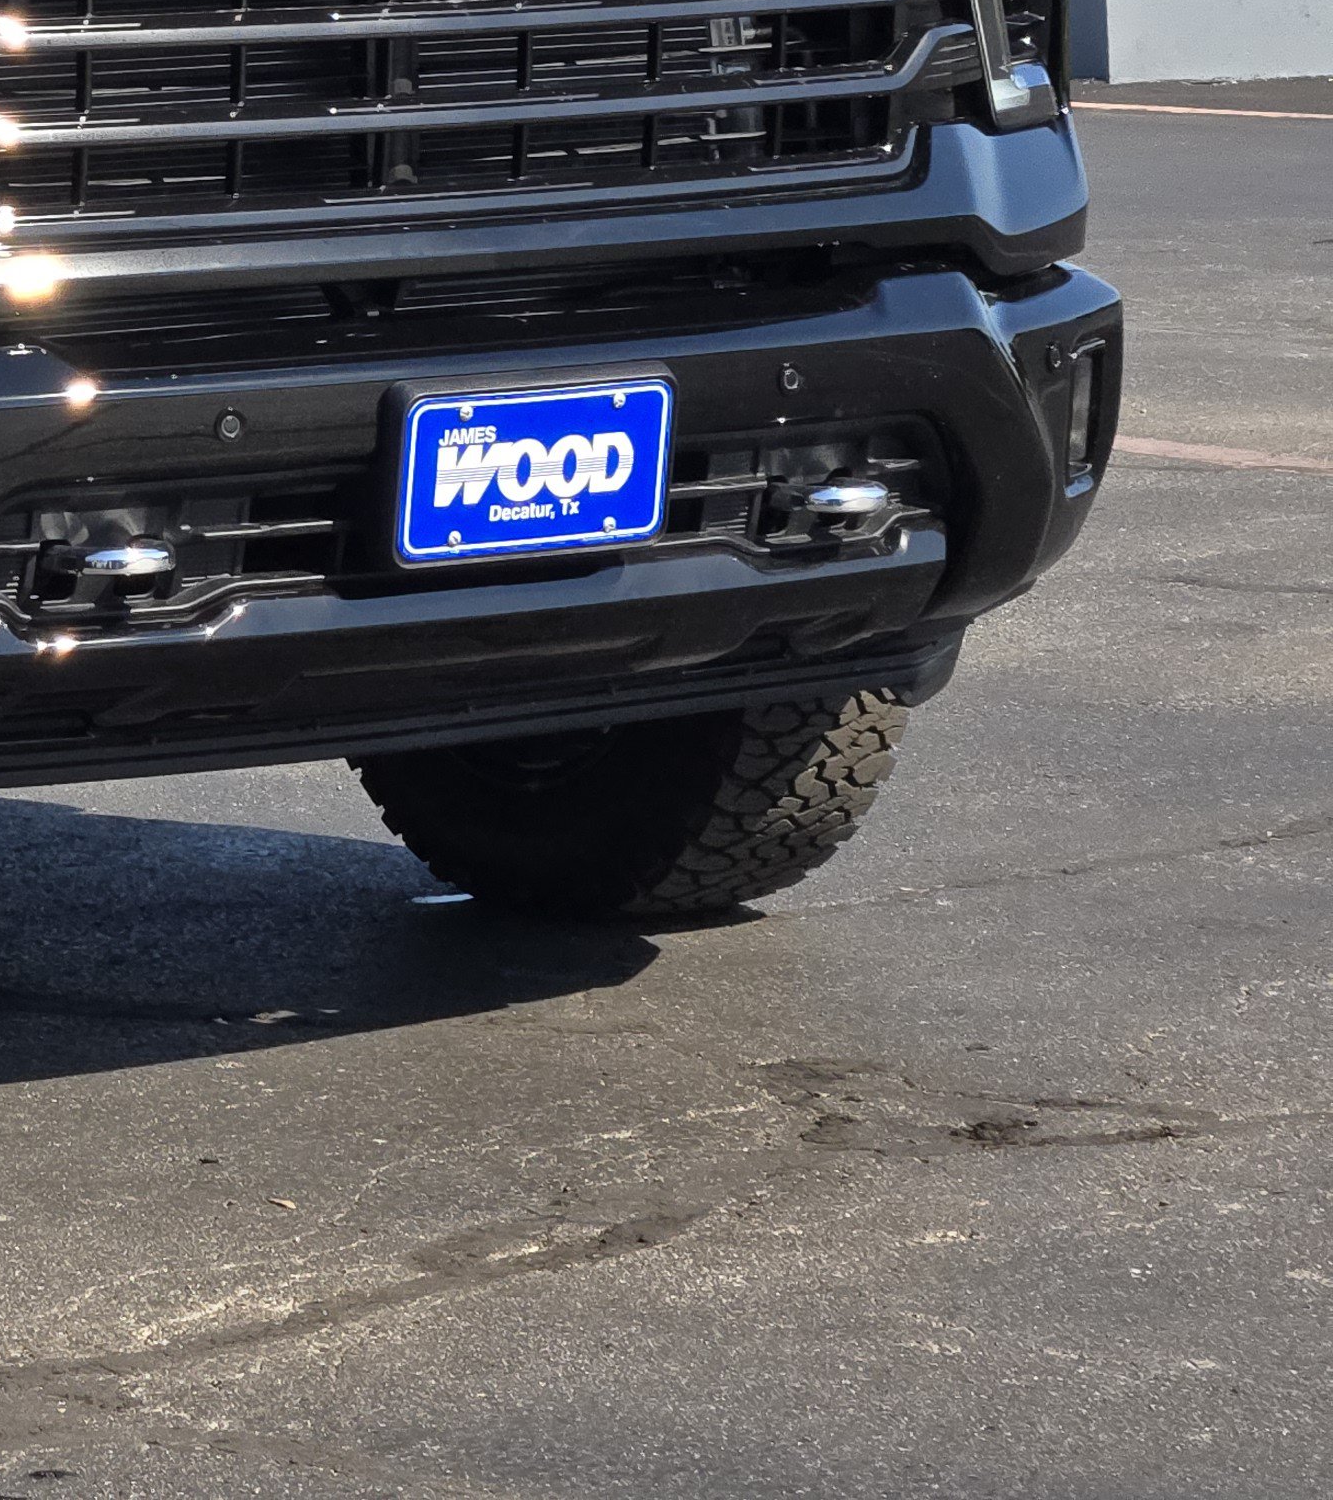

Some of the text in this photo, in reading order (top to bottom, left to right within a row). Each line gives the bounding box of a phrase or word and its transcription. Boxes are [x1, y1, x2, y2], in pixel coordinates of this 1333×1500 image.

[438, 426, 497, 446] JAMES
[433, 431, 634, 508] WOOD
[489, 498, 580, 522] Decatur, Tx
